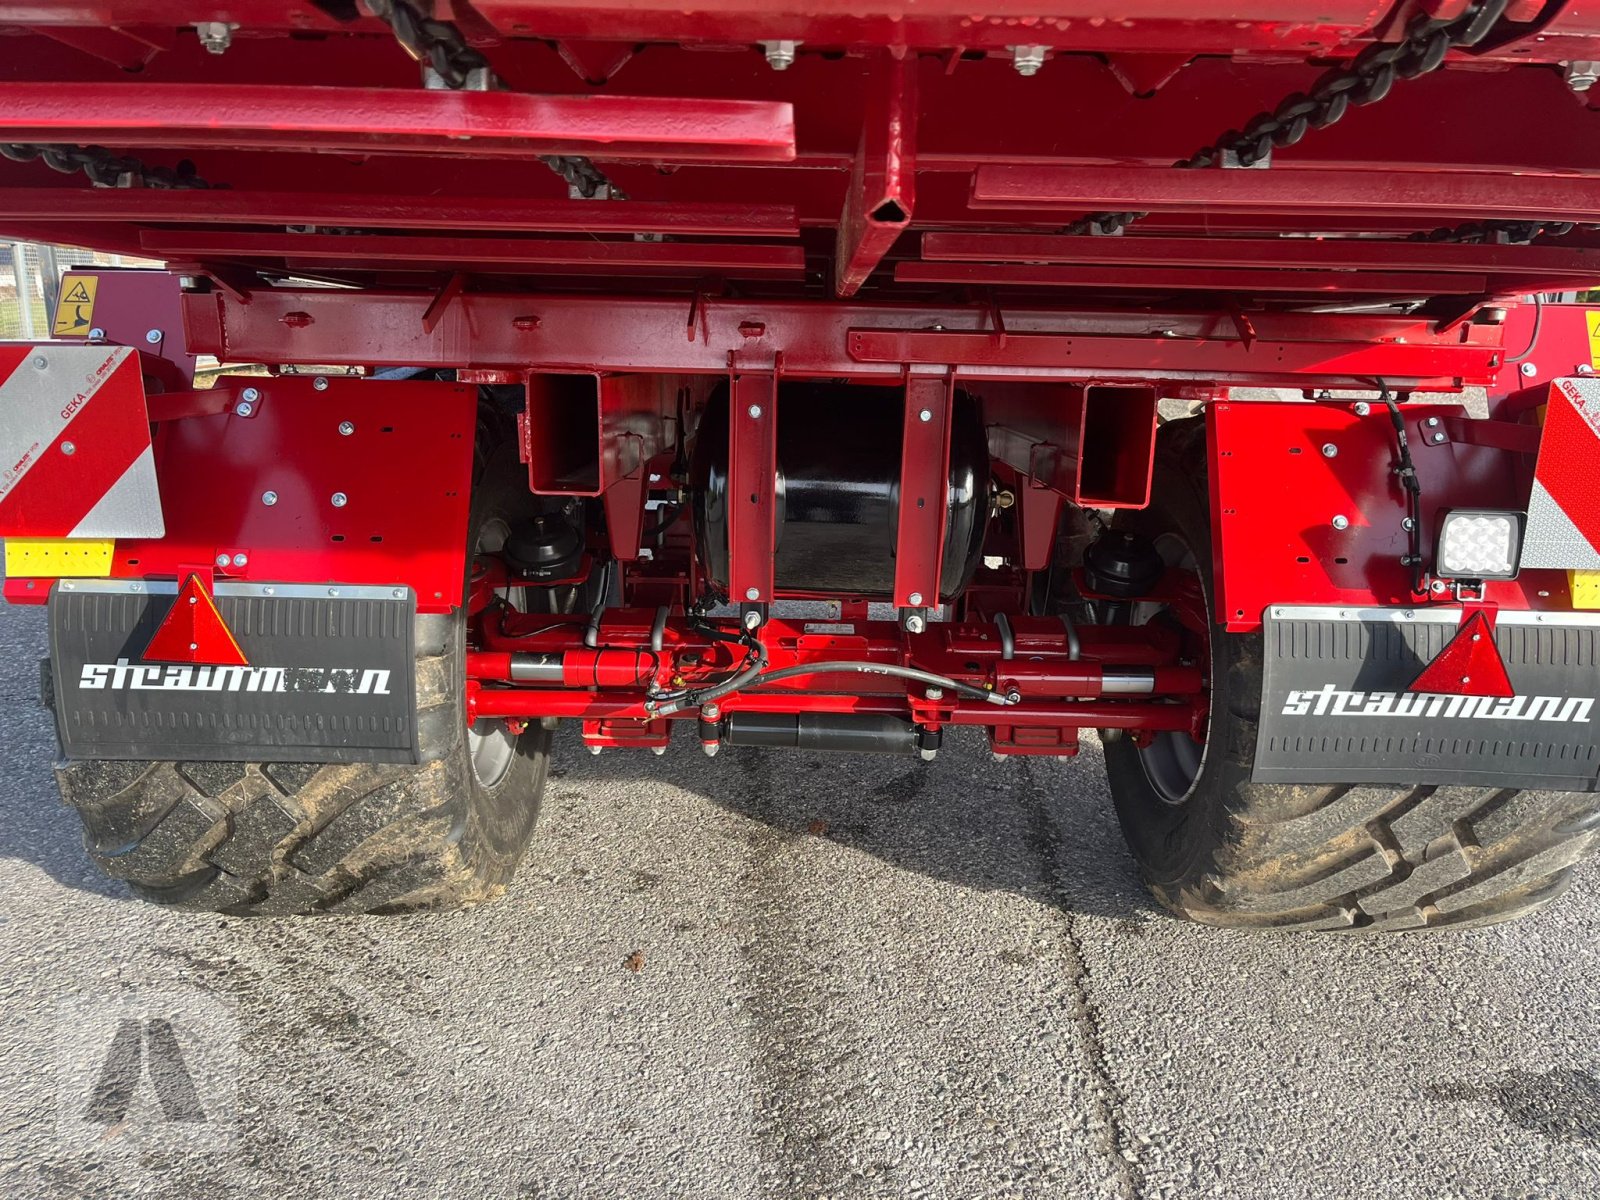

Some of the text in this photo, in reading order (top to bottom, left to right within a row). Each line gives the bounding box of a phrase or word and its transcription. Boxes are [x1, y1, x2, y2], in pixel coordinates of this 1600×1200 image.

[60, 393, 87, 420] GEKA
[1562, 380, 1586, 409] GEKA
[1281, 683, 1596, 723] straumann
